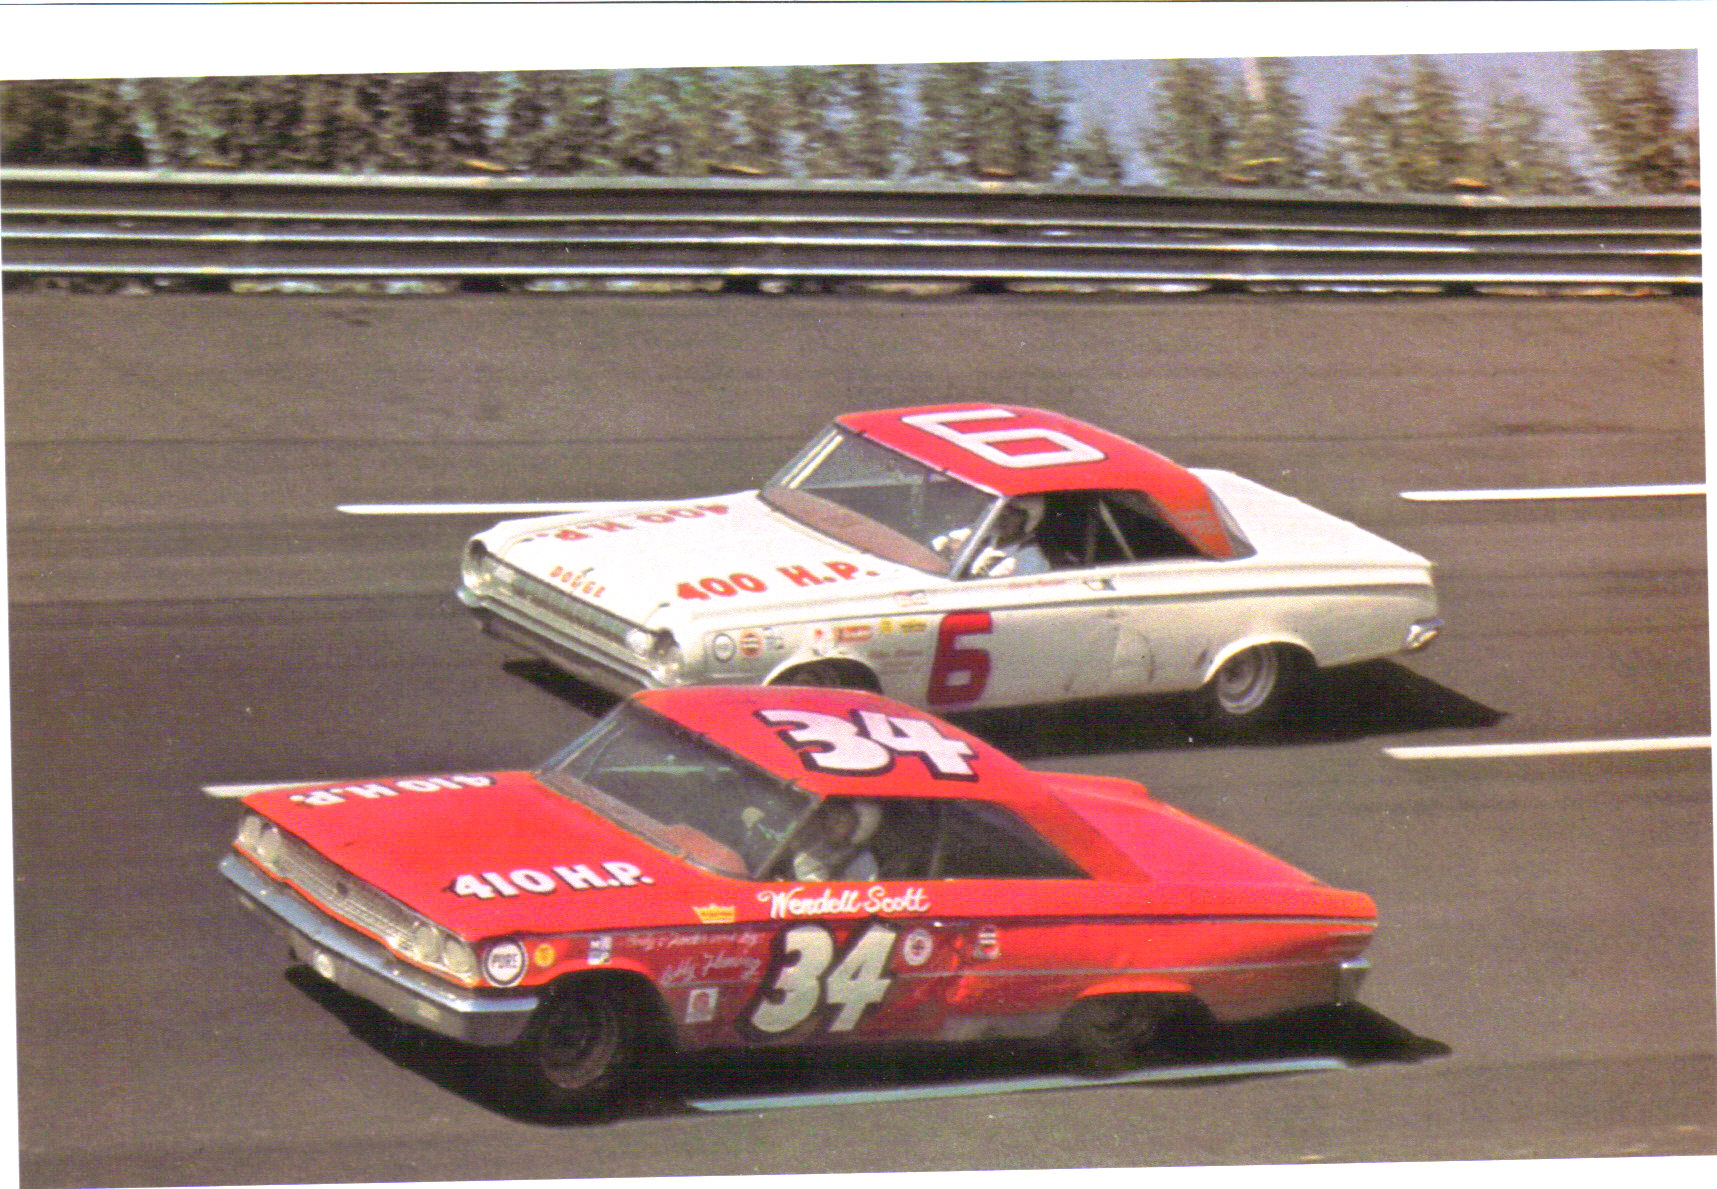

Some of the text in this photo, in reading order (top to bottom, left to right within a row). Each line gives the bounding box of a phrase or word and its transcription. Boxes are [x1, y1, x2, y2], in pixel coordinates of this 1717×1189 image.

[901, 408, 1107, 468] 6
[677, 560, 880, 600] 400 H.P.
[926, 610, 994, 710] 6
[754, 709, 980, 783] 34
[448, 860, 655, 900] 410 H.P.
[756, 886, 859, 918] Wendell
[862, 885, 931, 913] Scott
[748, 922, 898, 1034] 34
